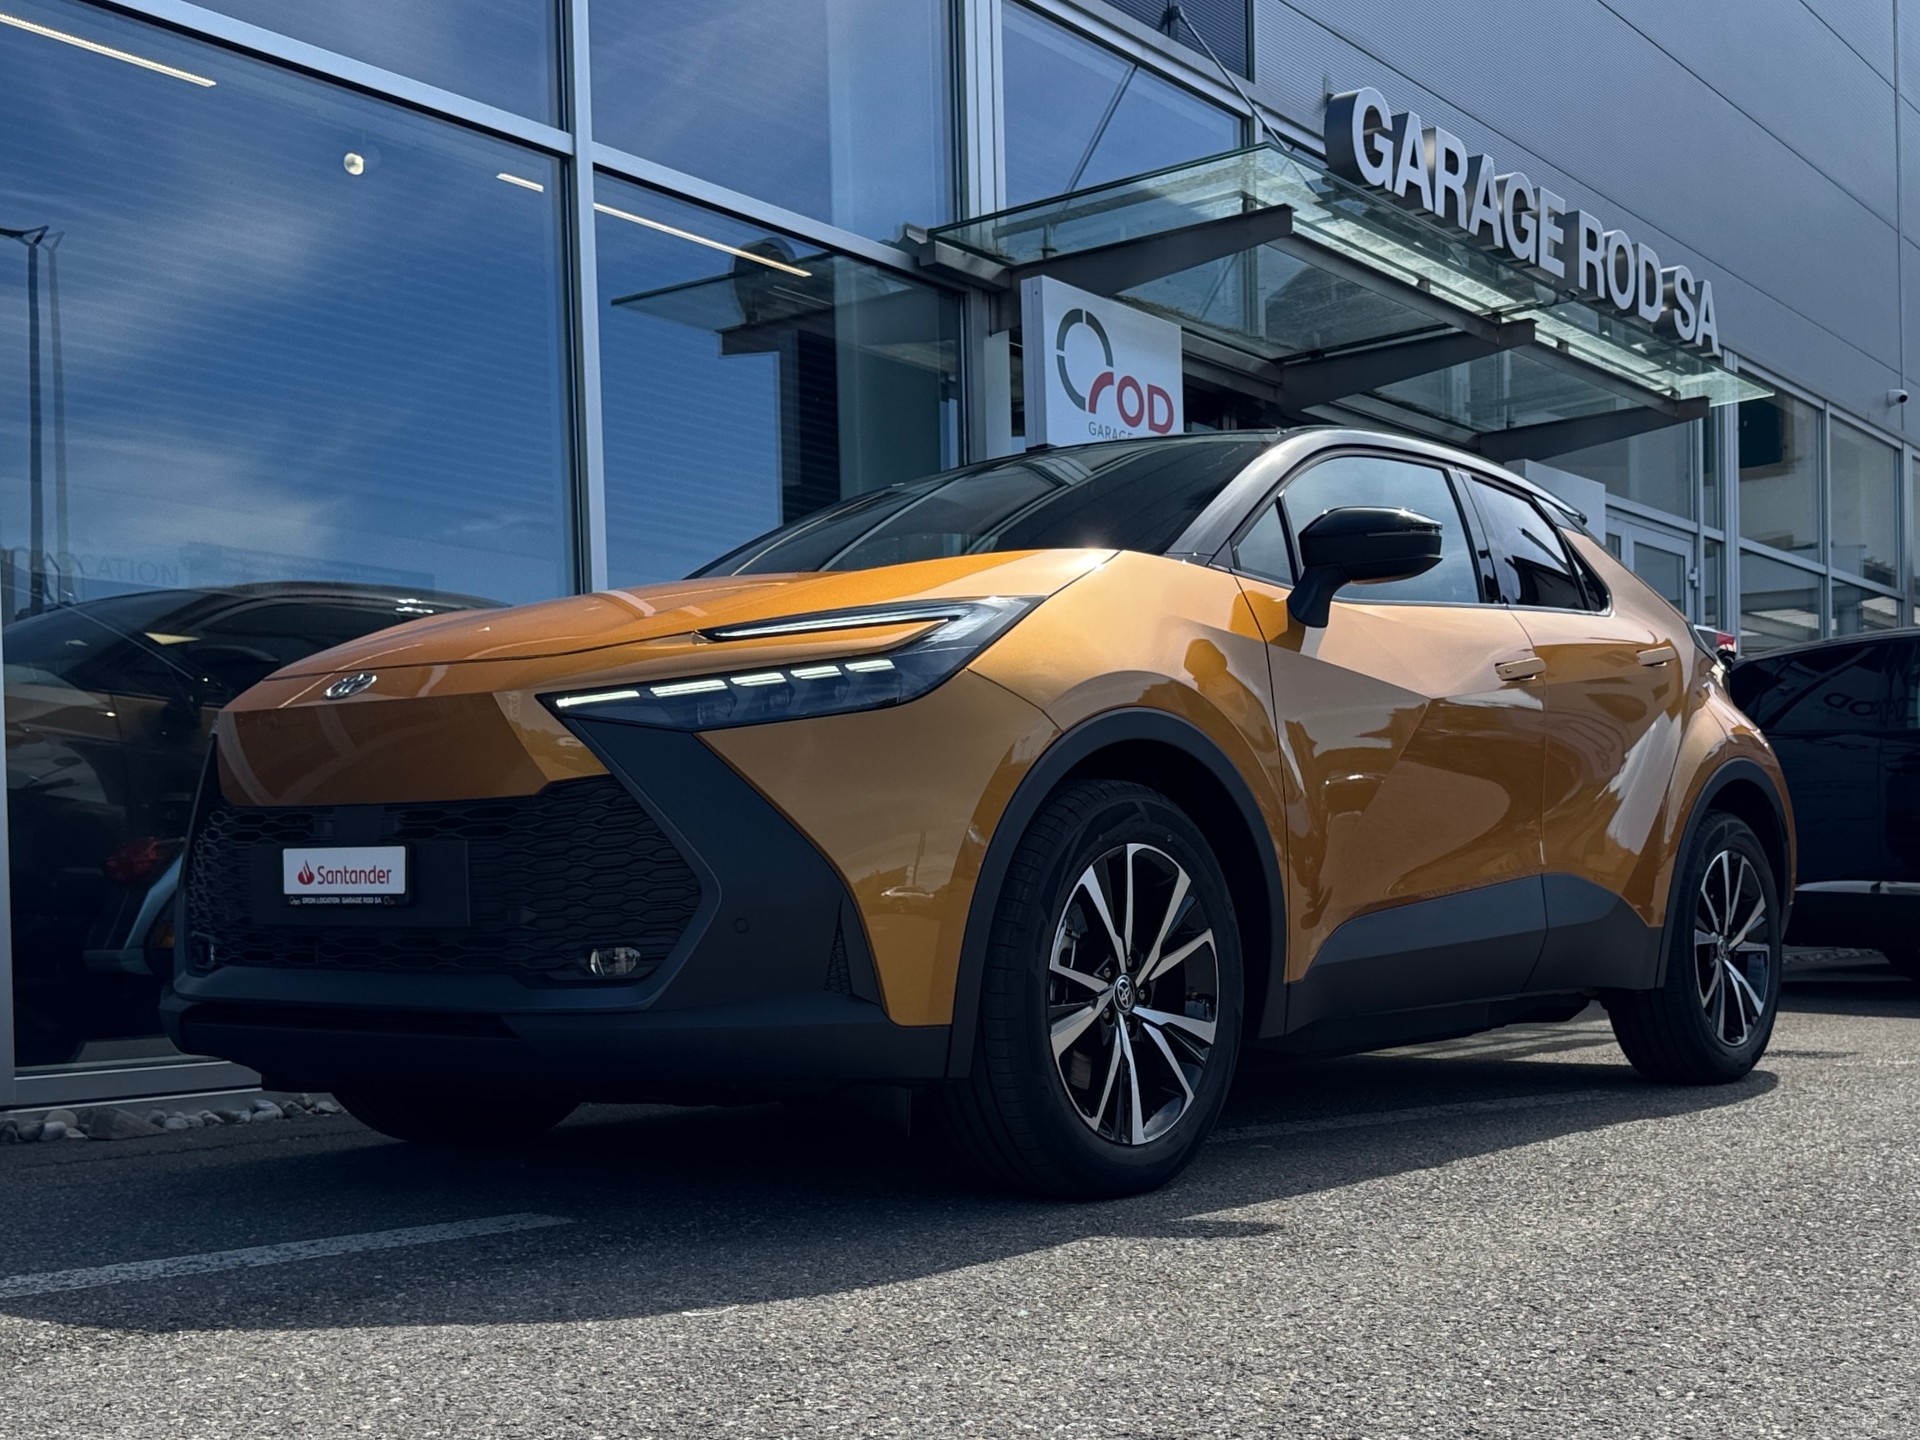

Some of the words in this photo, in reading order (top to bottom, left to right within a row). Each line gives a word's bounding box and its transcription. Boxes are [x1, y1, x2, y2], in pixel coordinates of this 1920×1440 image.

[1350, 86, 1566, 279] GARAGE
[1577, 209, 1664, 323] ROD
[1673, 264, 1720, 357] SA
[1088, 421, 1134, 440] GARA
[317, 865, 392, 885] Santander
